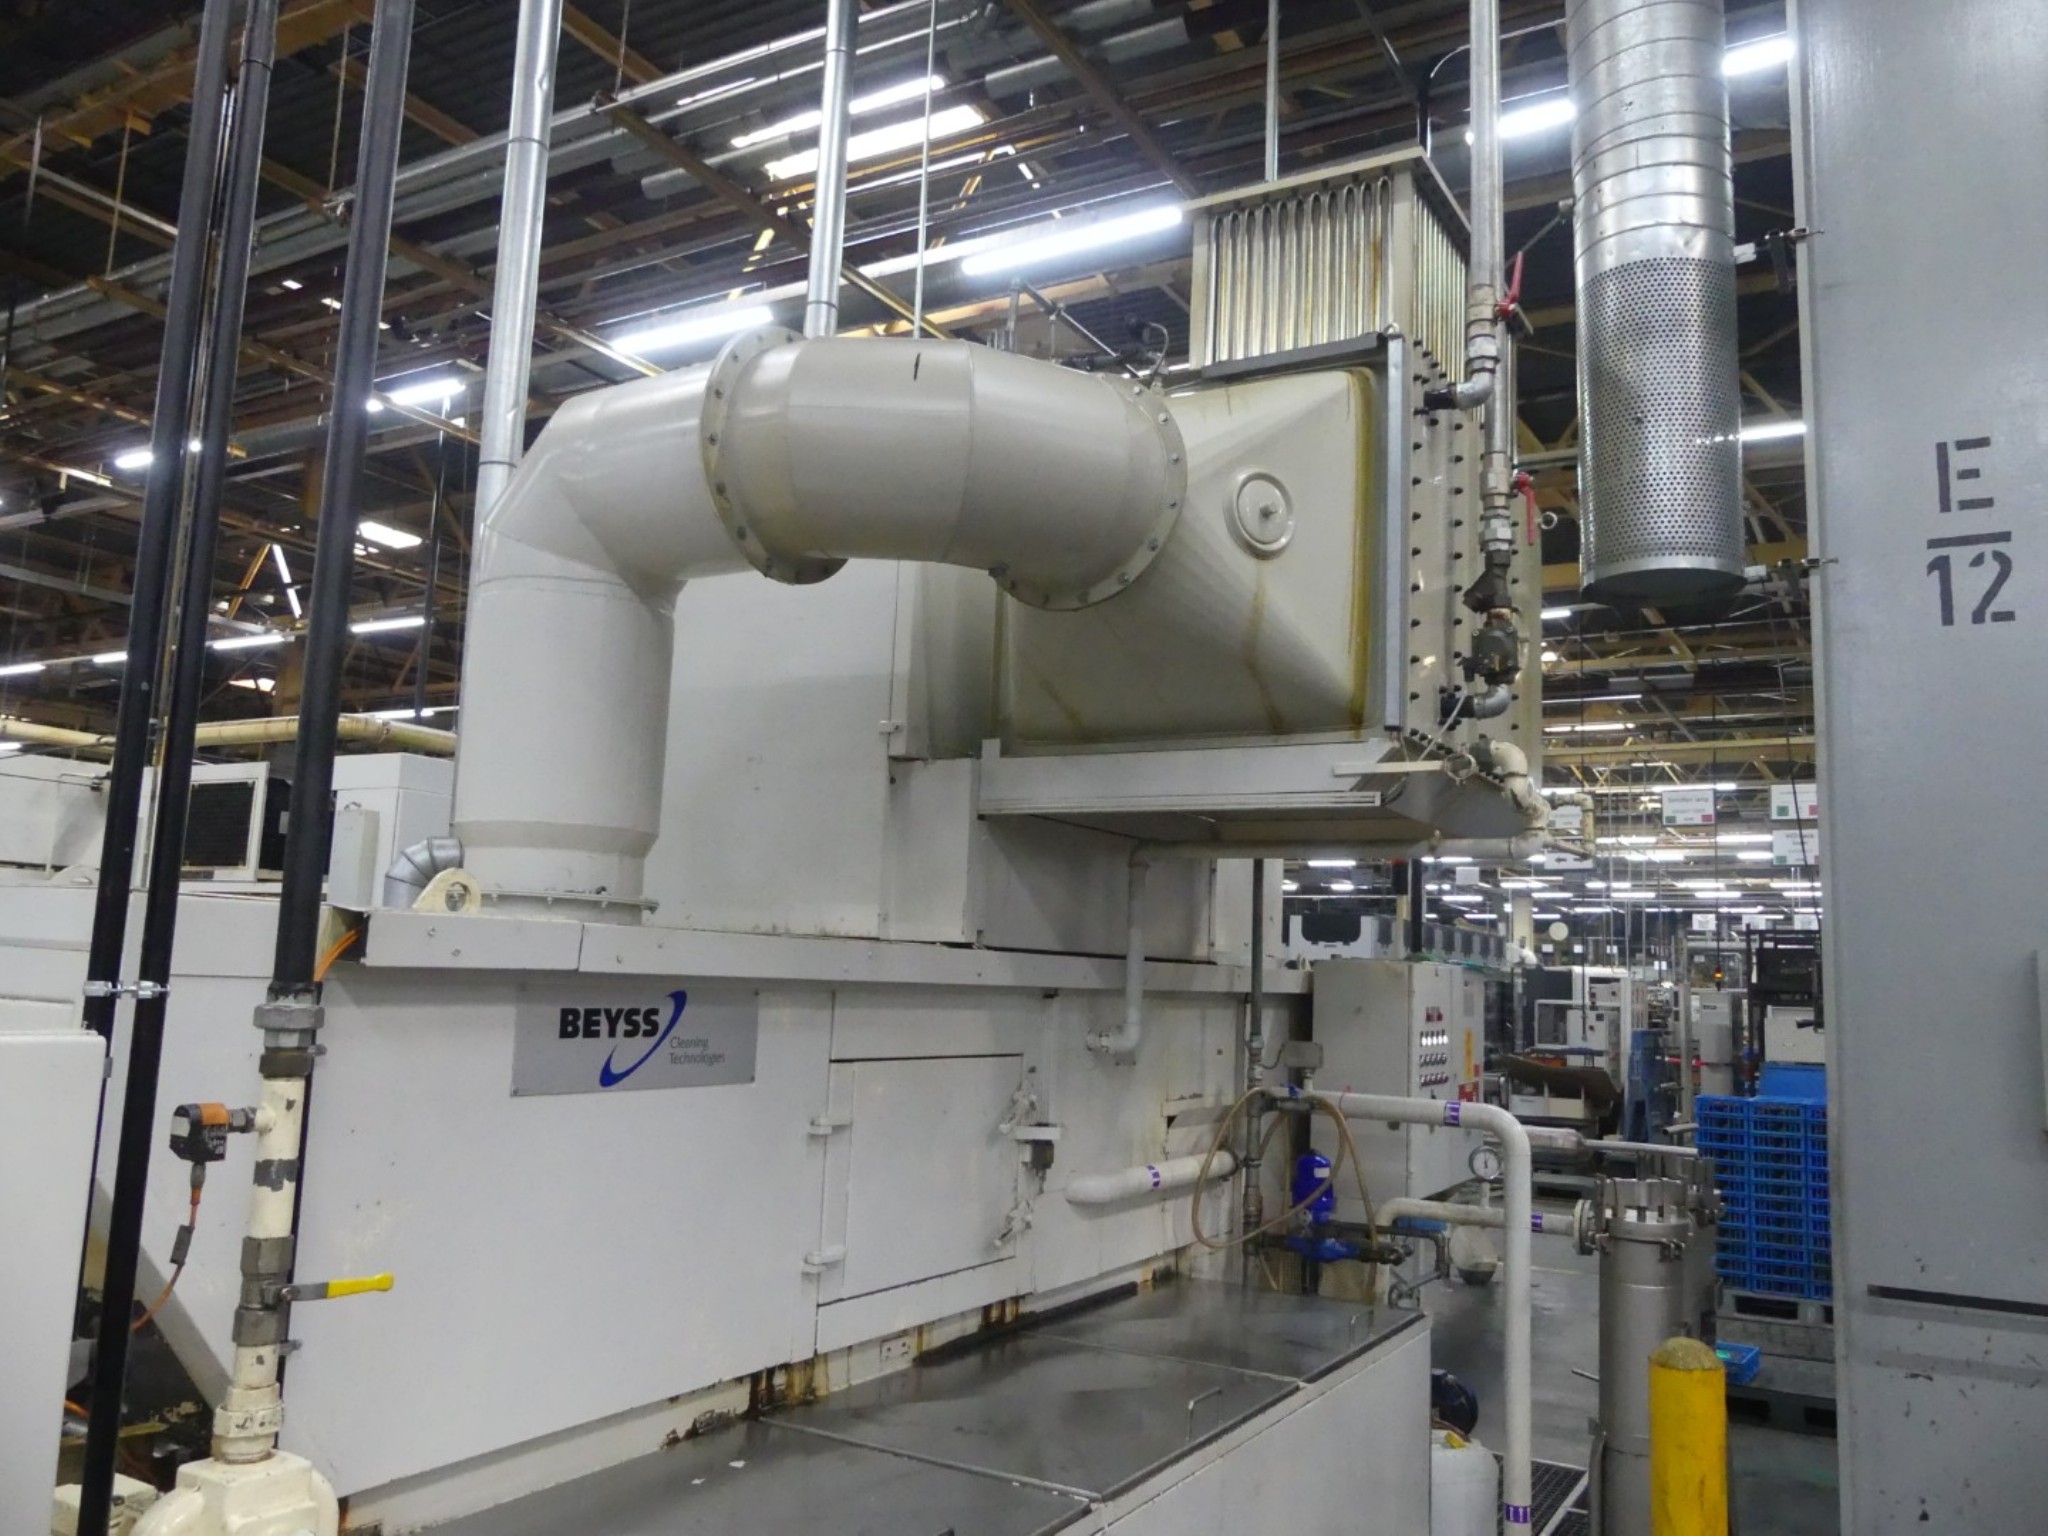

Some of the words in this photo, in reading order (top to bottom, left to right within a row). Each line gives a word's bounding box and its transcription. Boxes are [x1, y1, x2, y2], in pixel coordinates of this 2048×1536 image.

[1936, 436, 1994, 513] E
[1926, 549, 2016, 626] 12
[559, 1007, 660, 1039] BEYSS
[669, 1052, 726, 1066] Technologies
[670, 1036, 709, 1051] Cleaning
